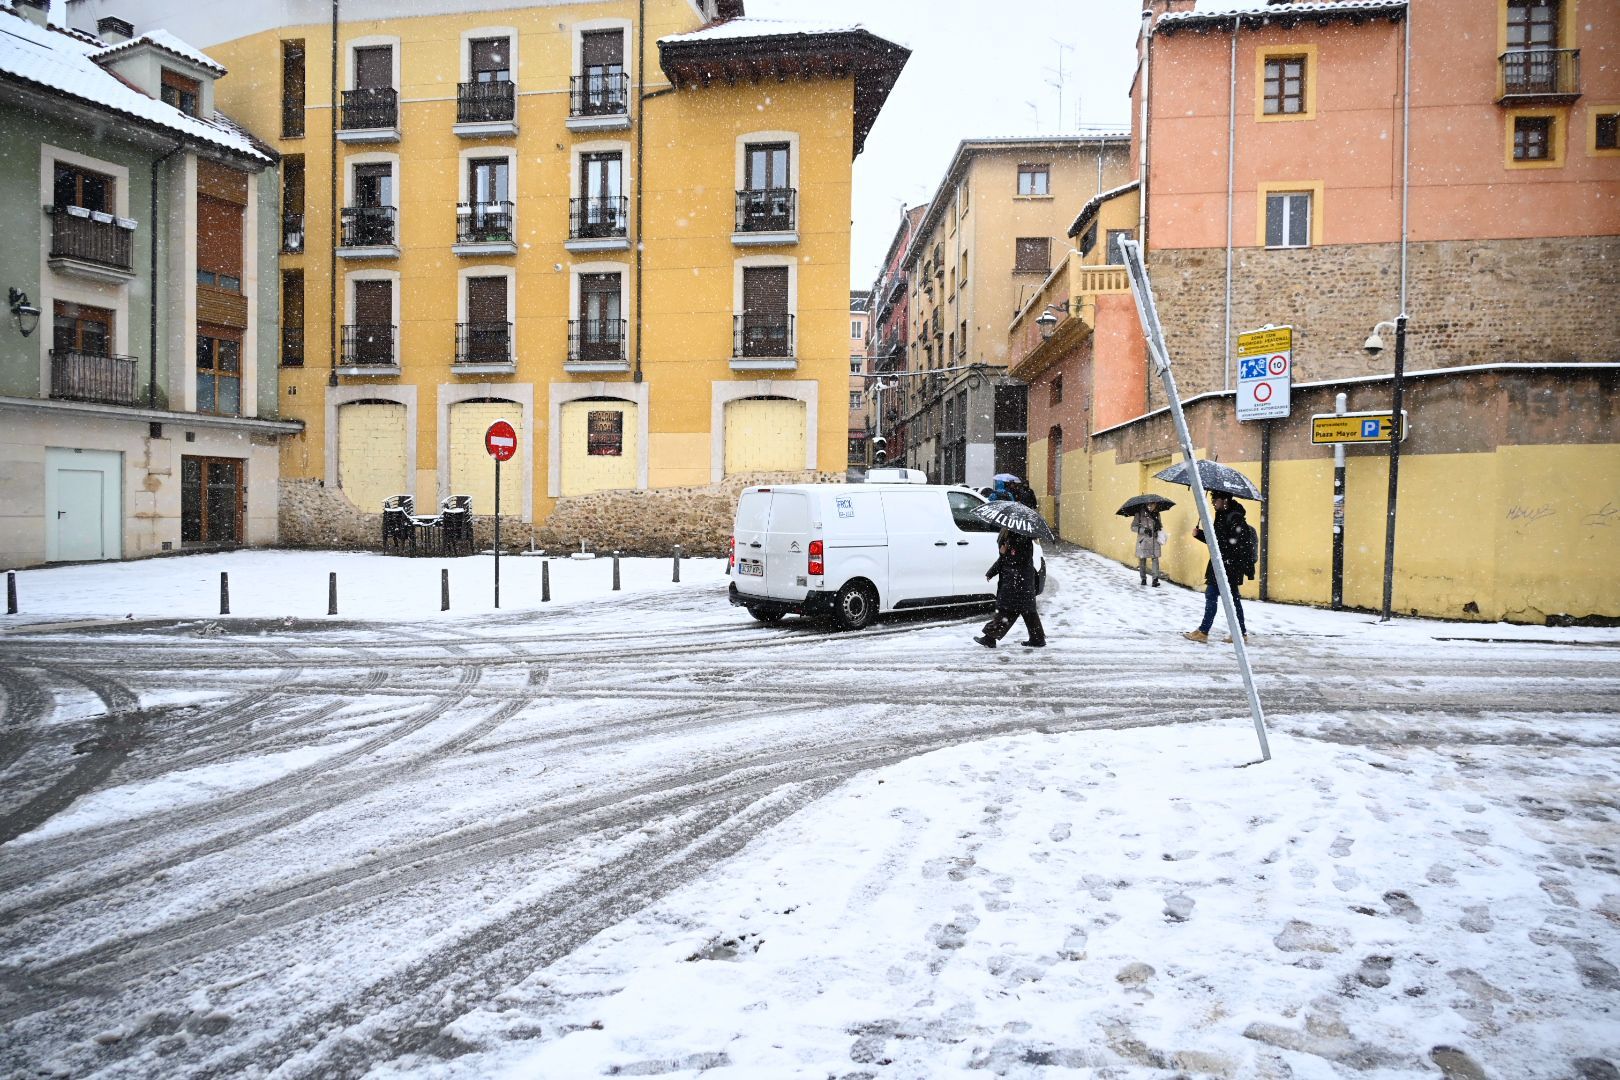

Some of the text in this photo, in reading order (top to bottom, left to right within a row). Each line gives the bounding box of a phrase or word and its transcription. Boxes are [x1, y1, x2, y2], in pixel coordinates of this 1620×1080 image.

[1273, 361, 1282, 369] 10
[1364, 421, 1376, 436] P
[1336, 431, 1357, 439] Mayor
[995, 513, 1033, 533] LLUVIA
